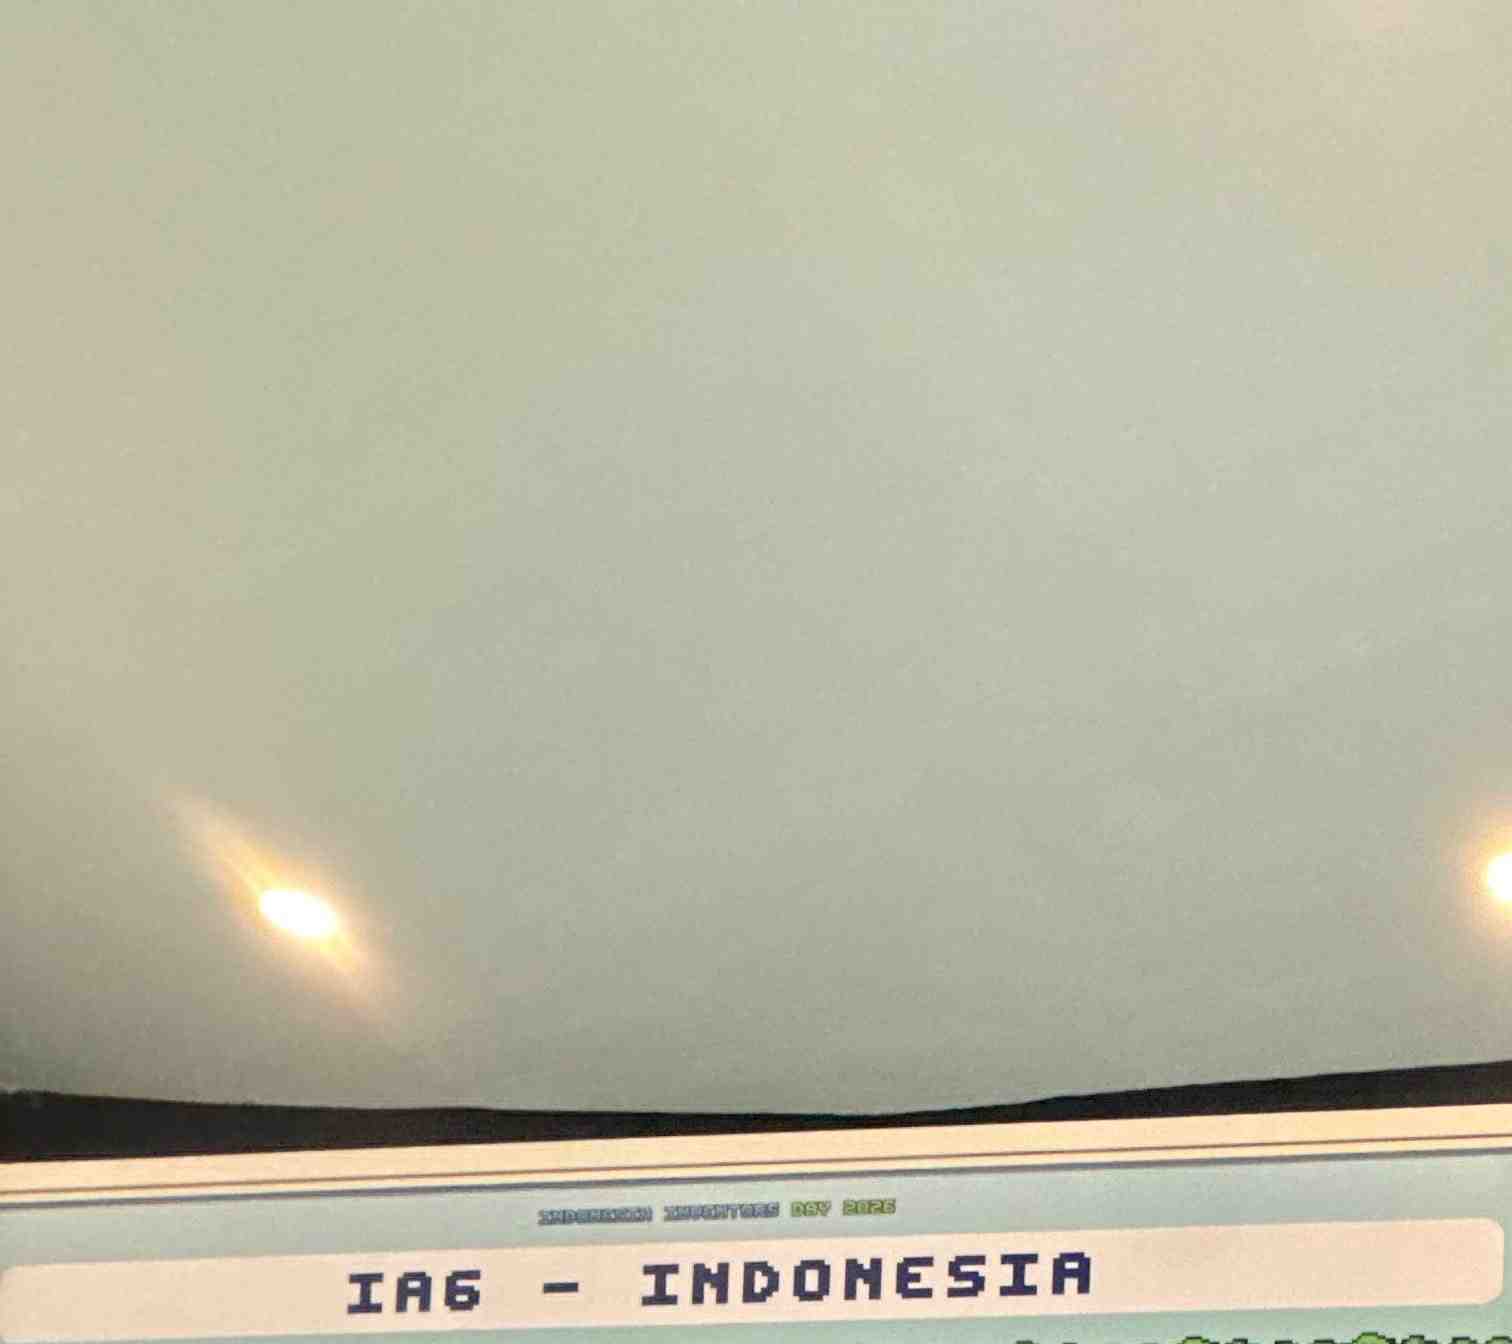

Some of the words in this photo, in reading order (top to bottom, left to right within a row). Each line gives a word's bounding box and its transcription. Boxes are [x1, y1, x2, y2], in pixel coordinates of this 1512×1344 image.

[789, 1200, 832, 1217] DAY
[841, 1198, 897, 1216] 2026
[347, 1270, 482, 1314] IA6
[542, 1281, 580, 1294] -
[641, 1252, 1093, 1307] INDONESIA
